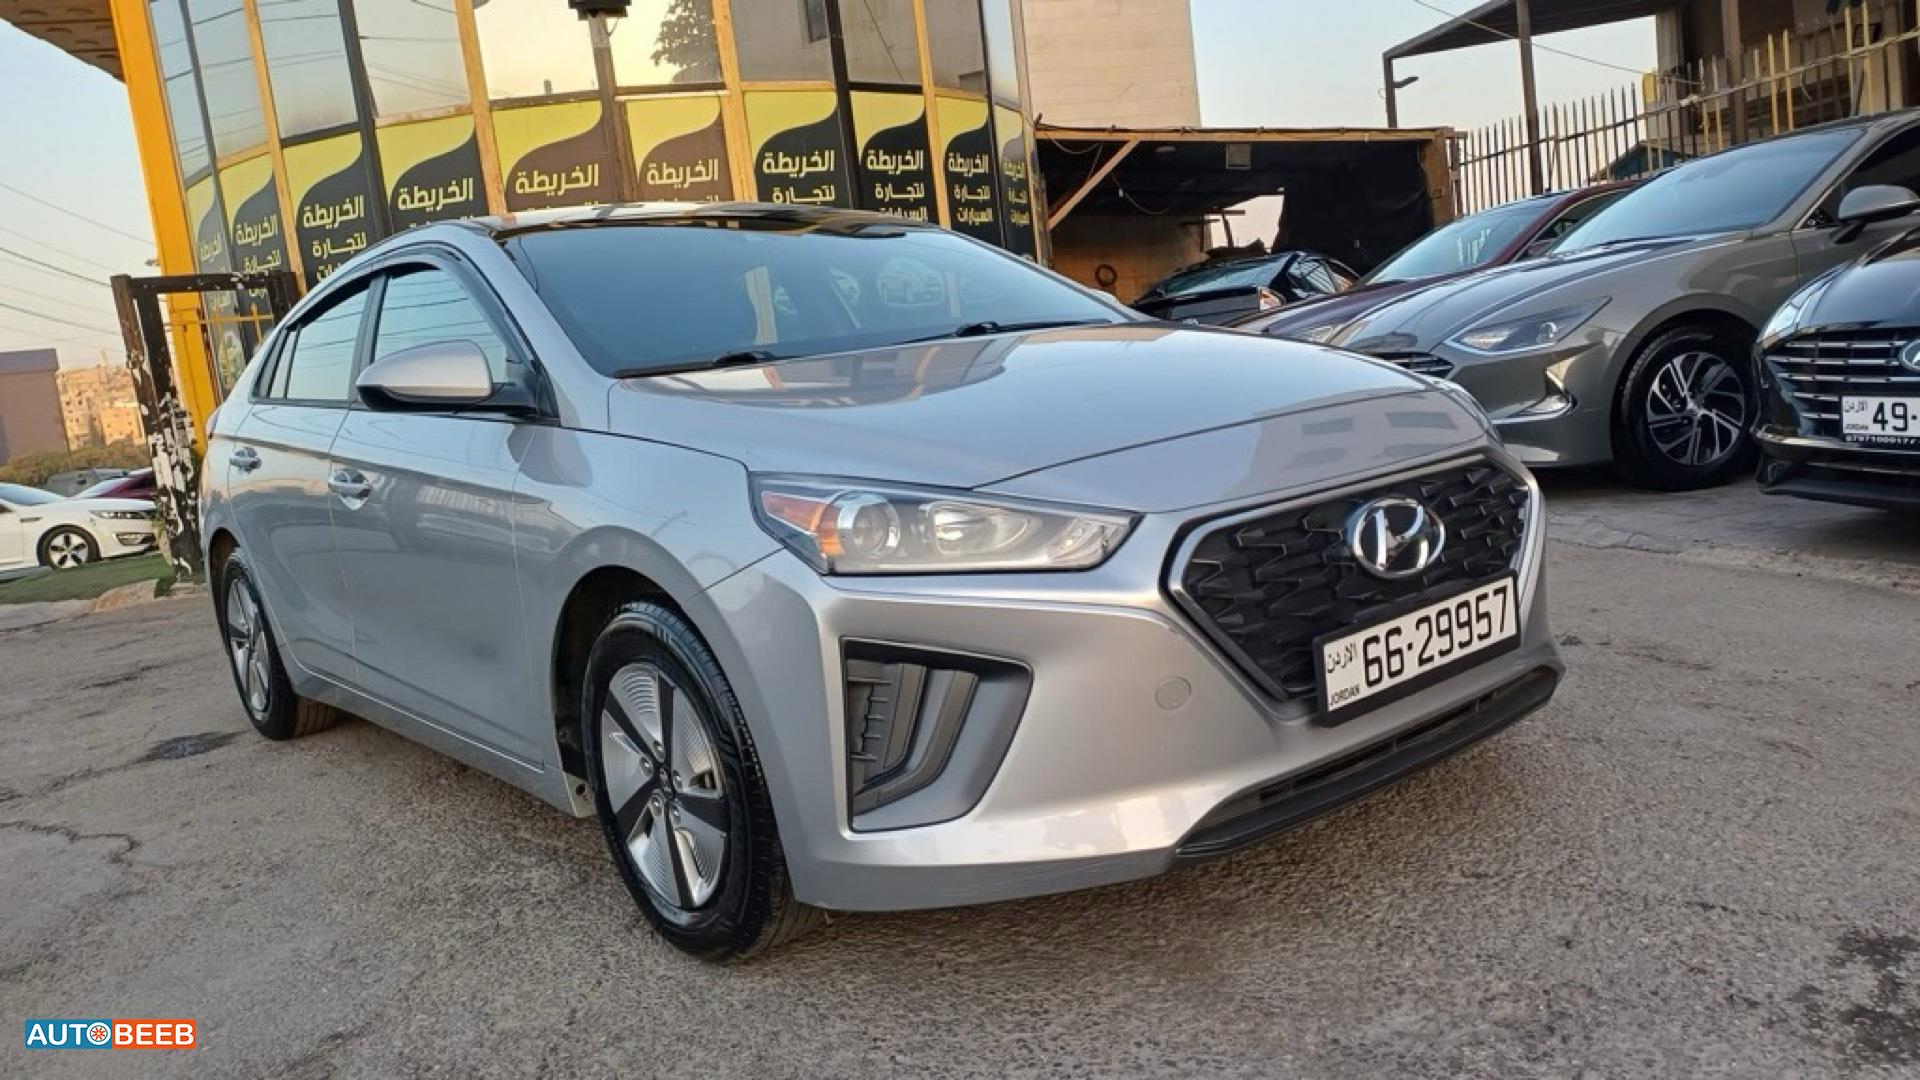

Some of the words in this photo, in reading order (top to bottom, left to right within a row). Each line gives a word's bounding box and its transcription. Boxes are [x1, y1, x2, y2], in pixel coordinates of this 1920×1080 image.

[646, 159, 719, 188] الخريطة
[763, 149, 835, 179] الخريطة
[867, 149, 924, 175] الخريطة
[949, 152, 989, 178] الخريطة
[515, 163, 599, 196] الخريطة
[397, 177, 474, 213] الخريطة
[303, 194, 365, 230] الخريطة
[236, 213, 278, 247] الخريطة
[1329, 683, 1360, 707] JORDAN
